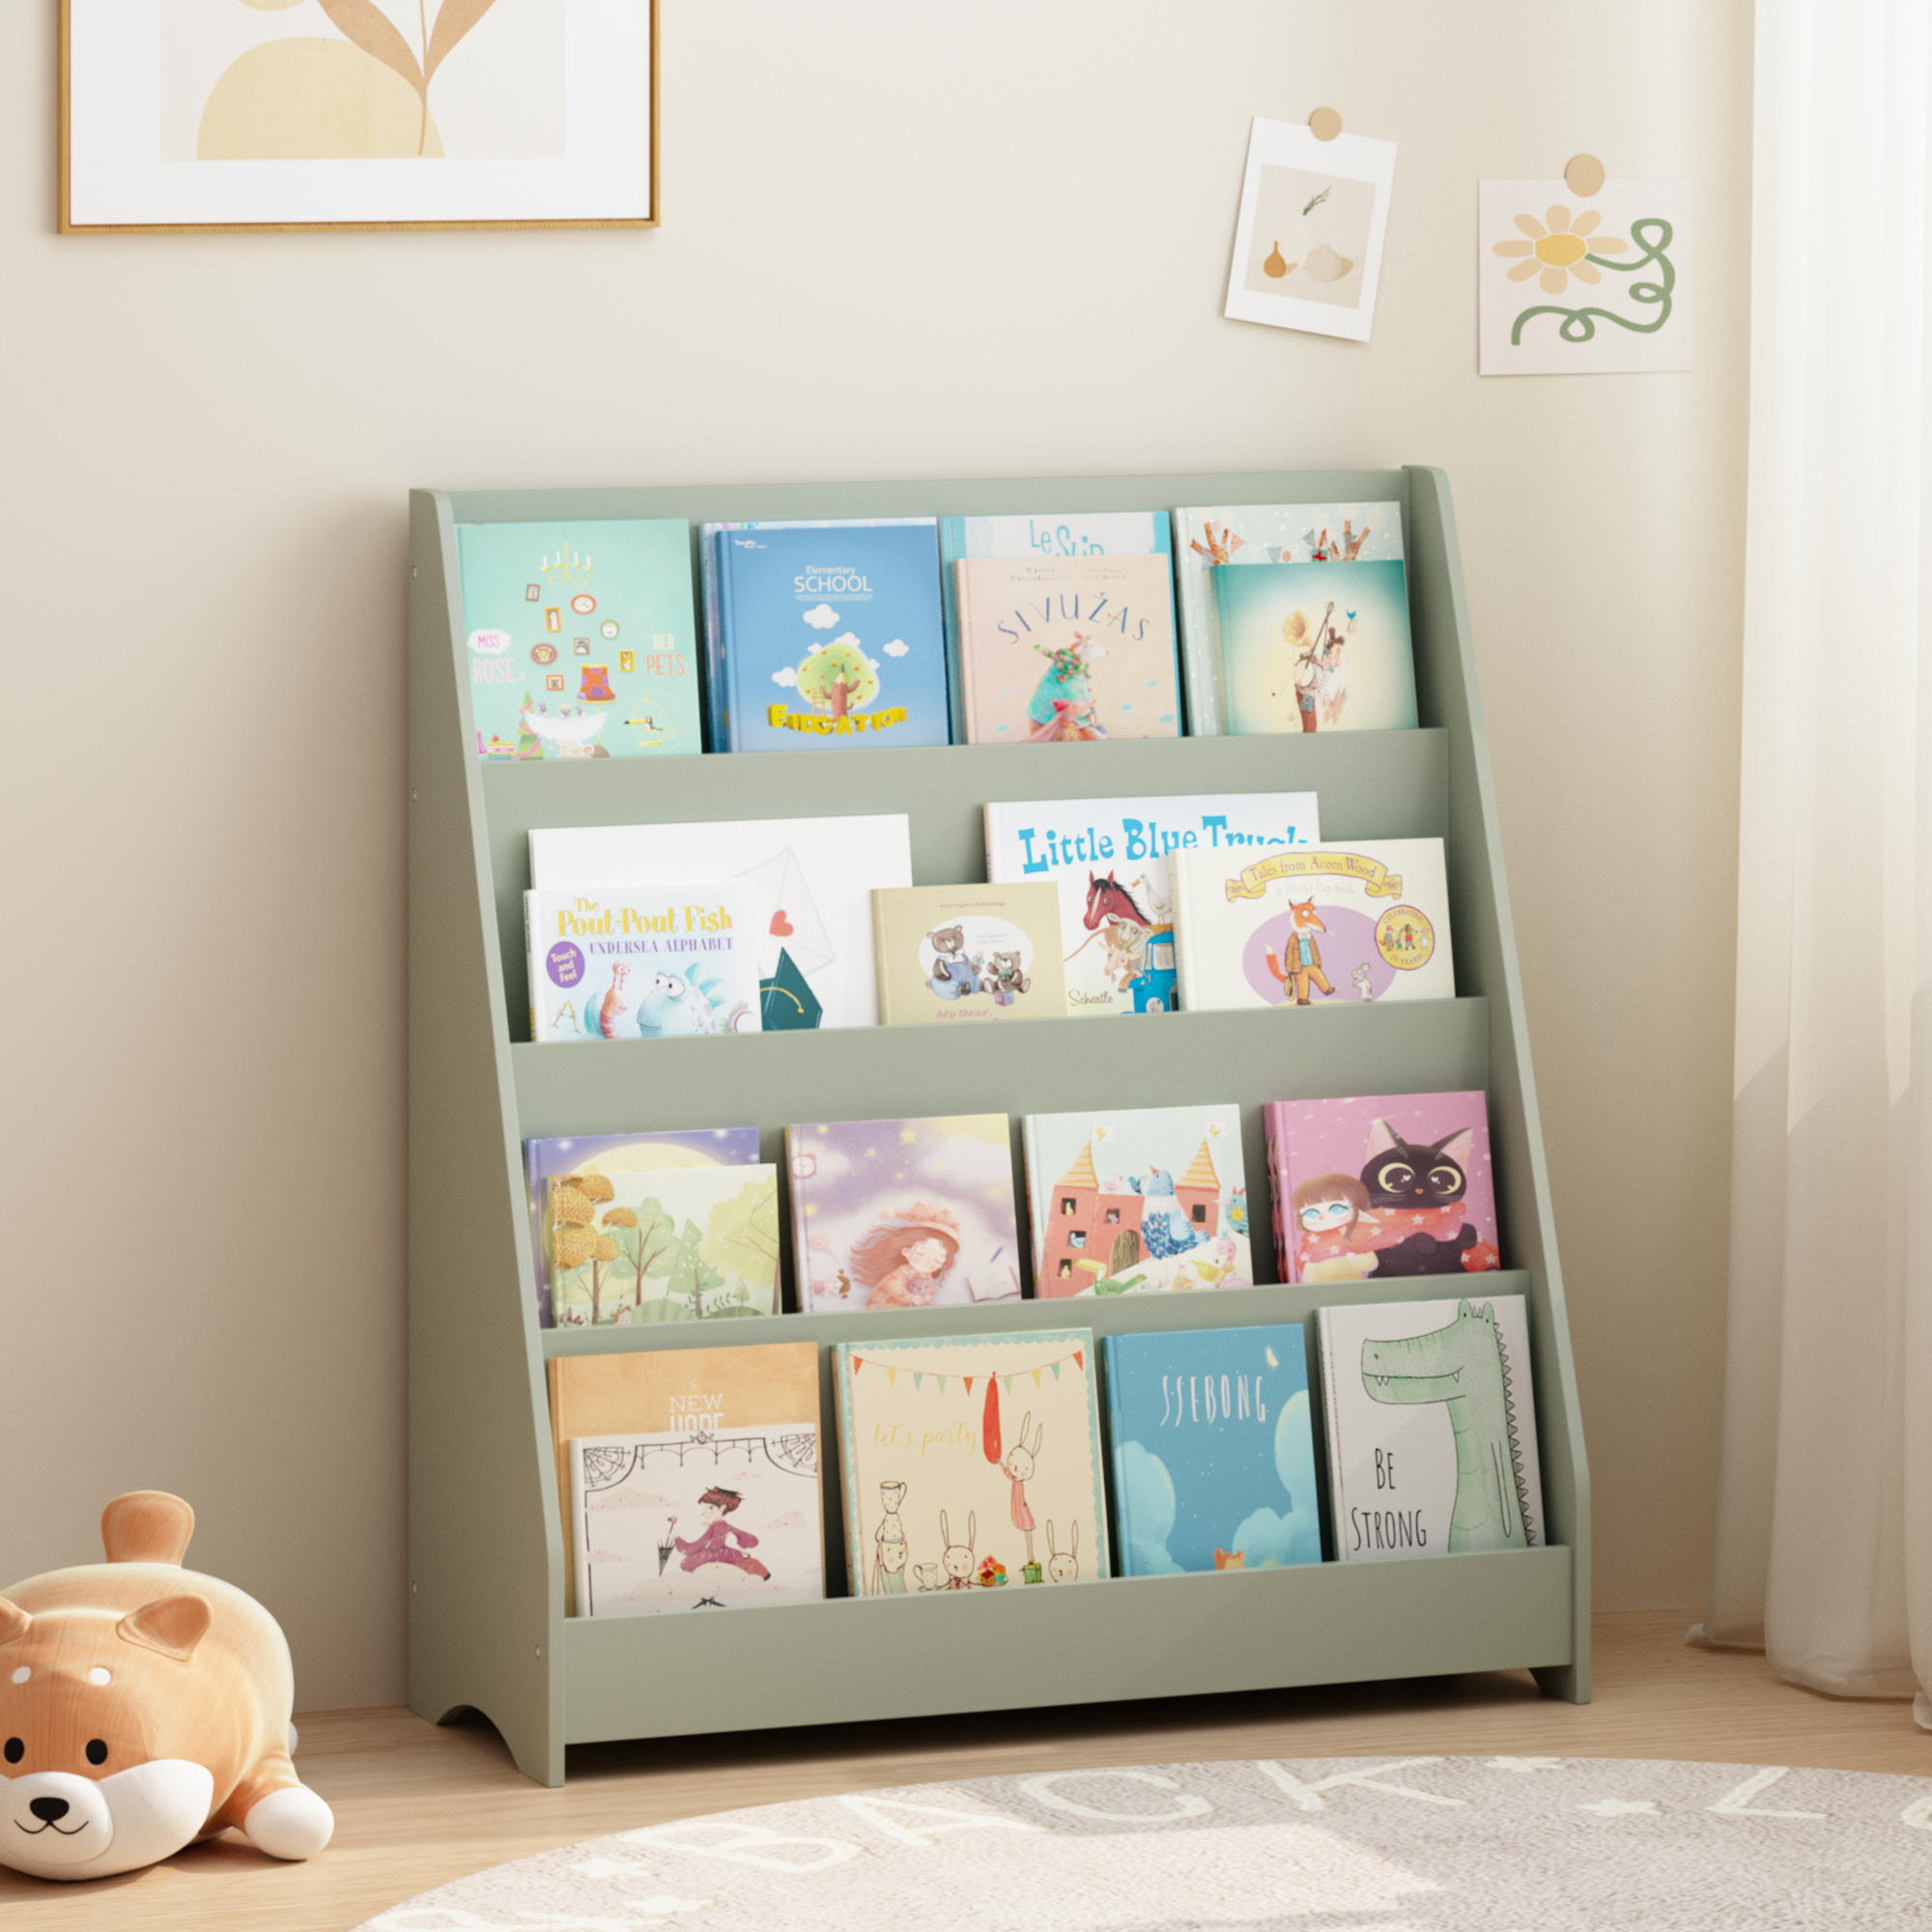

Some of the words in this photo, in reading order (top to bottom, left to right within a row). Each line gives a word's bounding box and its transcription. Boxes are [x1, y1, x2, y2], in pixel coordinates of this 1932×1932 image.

[1029, 519, 1052, 554] Le
[806, 565, 856, 576] Elementary
[794, 575, 873, 593] SCHOOL
[997, 590, 1150, 645] SIVUŽAS
[477, 635, 500, 648] MISS
[653, 634, 675, 650] HER
[473, 658, 517, 683] ROSE
[646, 653, 685, 676] PETS
[1018, 827, 1115, 874] Little
[1122, 818, 1199, 861] Blue
[1248, 865, 1277, 881] Tales
[1280, 859, 1306, 873] from
[1310, 856, 1343, 869] Acorn
[1346, 856, 1378, 878] Wood
[1335, 882, 1354, 895] book
[574, 897, 600, 912] The
[554, 906, 678, 937] Pout-Pout
[682, 905, 733, 933] Fish
[550, 948, 577, 964] Touch
[589, 940, 658, 955] UNDERSEA
[664, 937, 734, 952] ALPHABET
[557, 960, 575, 973] and
[559, 970, 578, 983] Feel
[1068, 989, 1114, 1007] Schertle
[936, 1010, 956, 1019] My
[668, 1393, 724, 1413] NEW
[1160, 1375, 1266, 1427] SSEBONG
[873, 1423, 915, 1447] let's
[921, 1421, 979, 1458] party
[1375, 1448, 1397, 1490] BE
[1351, 1508, 1428, 1551] STRONG
[623, 1755, 1468, 1873] BACK
